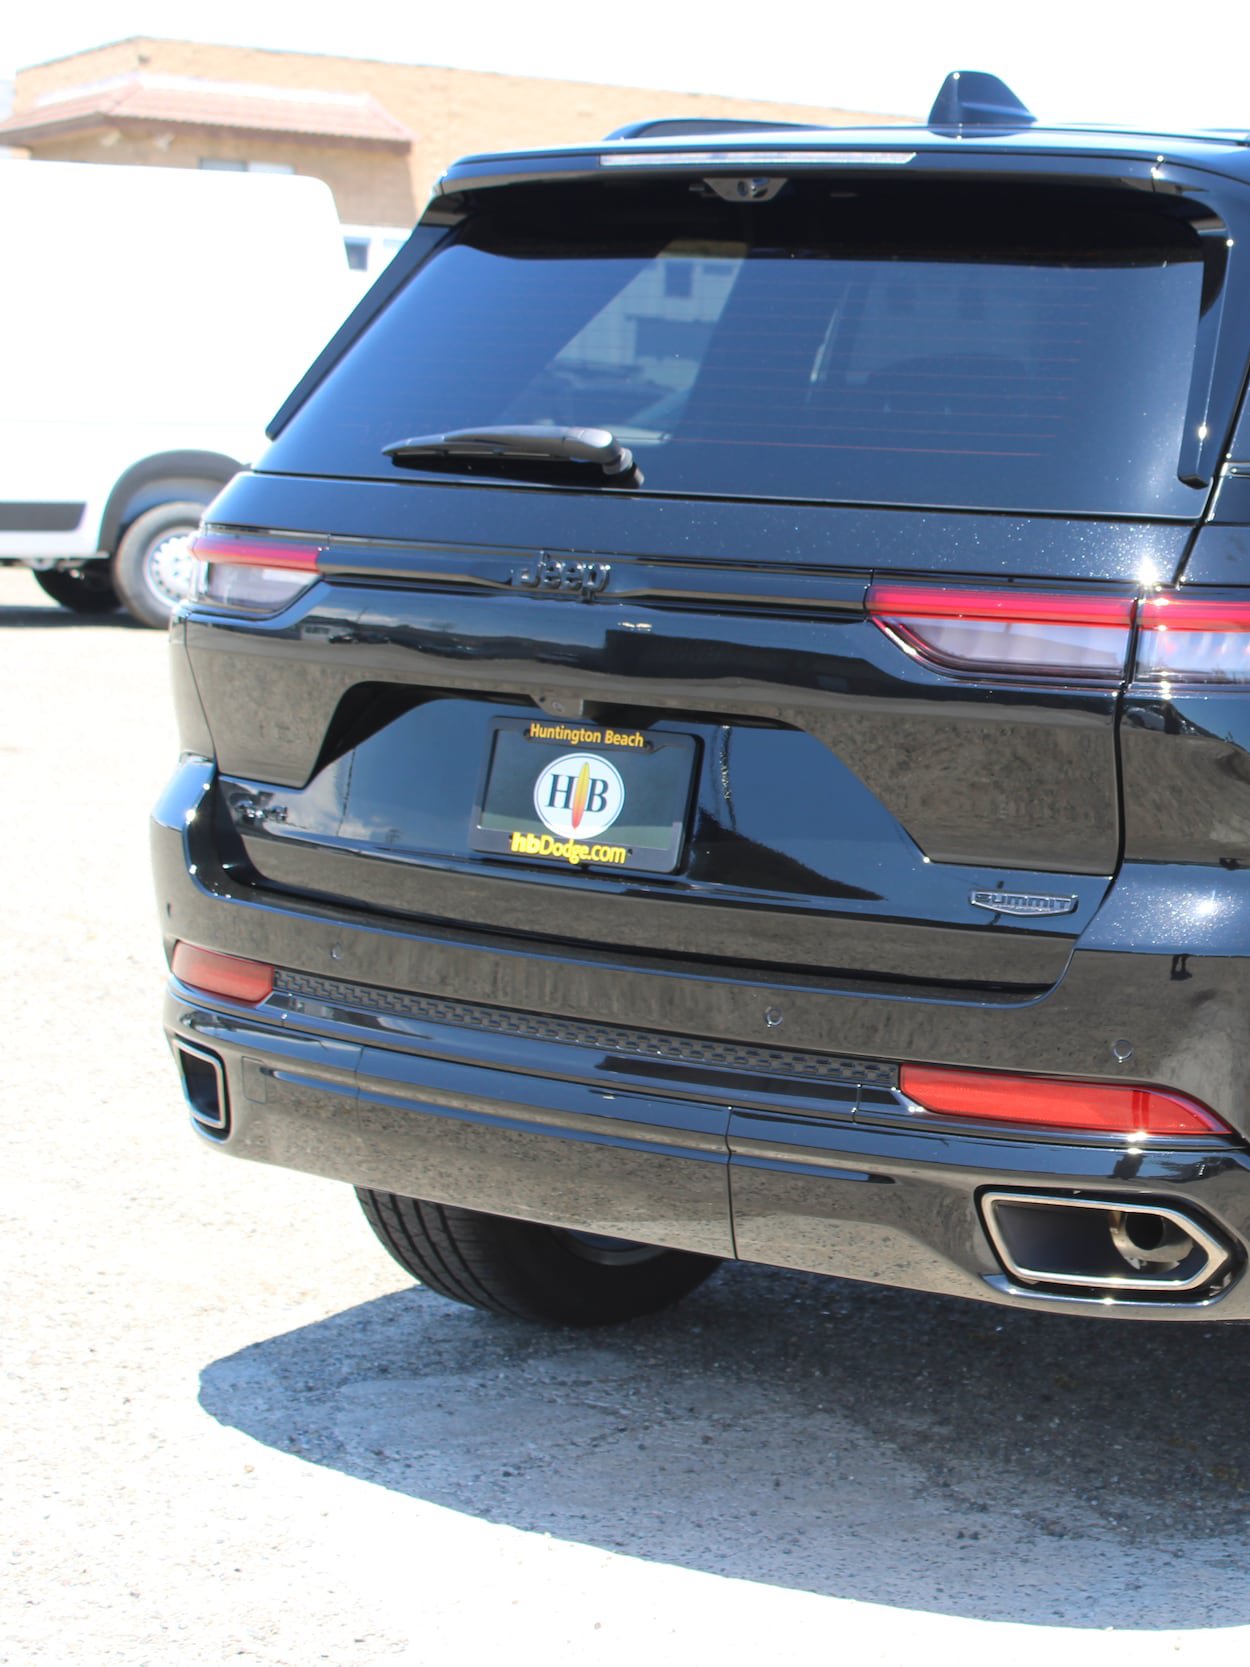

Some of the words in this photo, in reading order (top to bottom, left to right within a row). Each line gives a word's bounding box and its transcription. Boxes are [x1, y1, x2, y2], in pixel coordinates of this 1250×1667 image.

[520, 550, 610, 603] Jeep
[530, 723, 601, 744] Huntington
[605, 728, 644, 747] Beach
[510, 831, 627, 865] hbDodge.com
[975, 893, 1069, 911] SUMMIT
